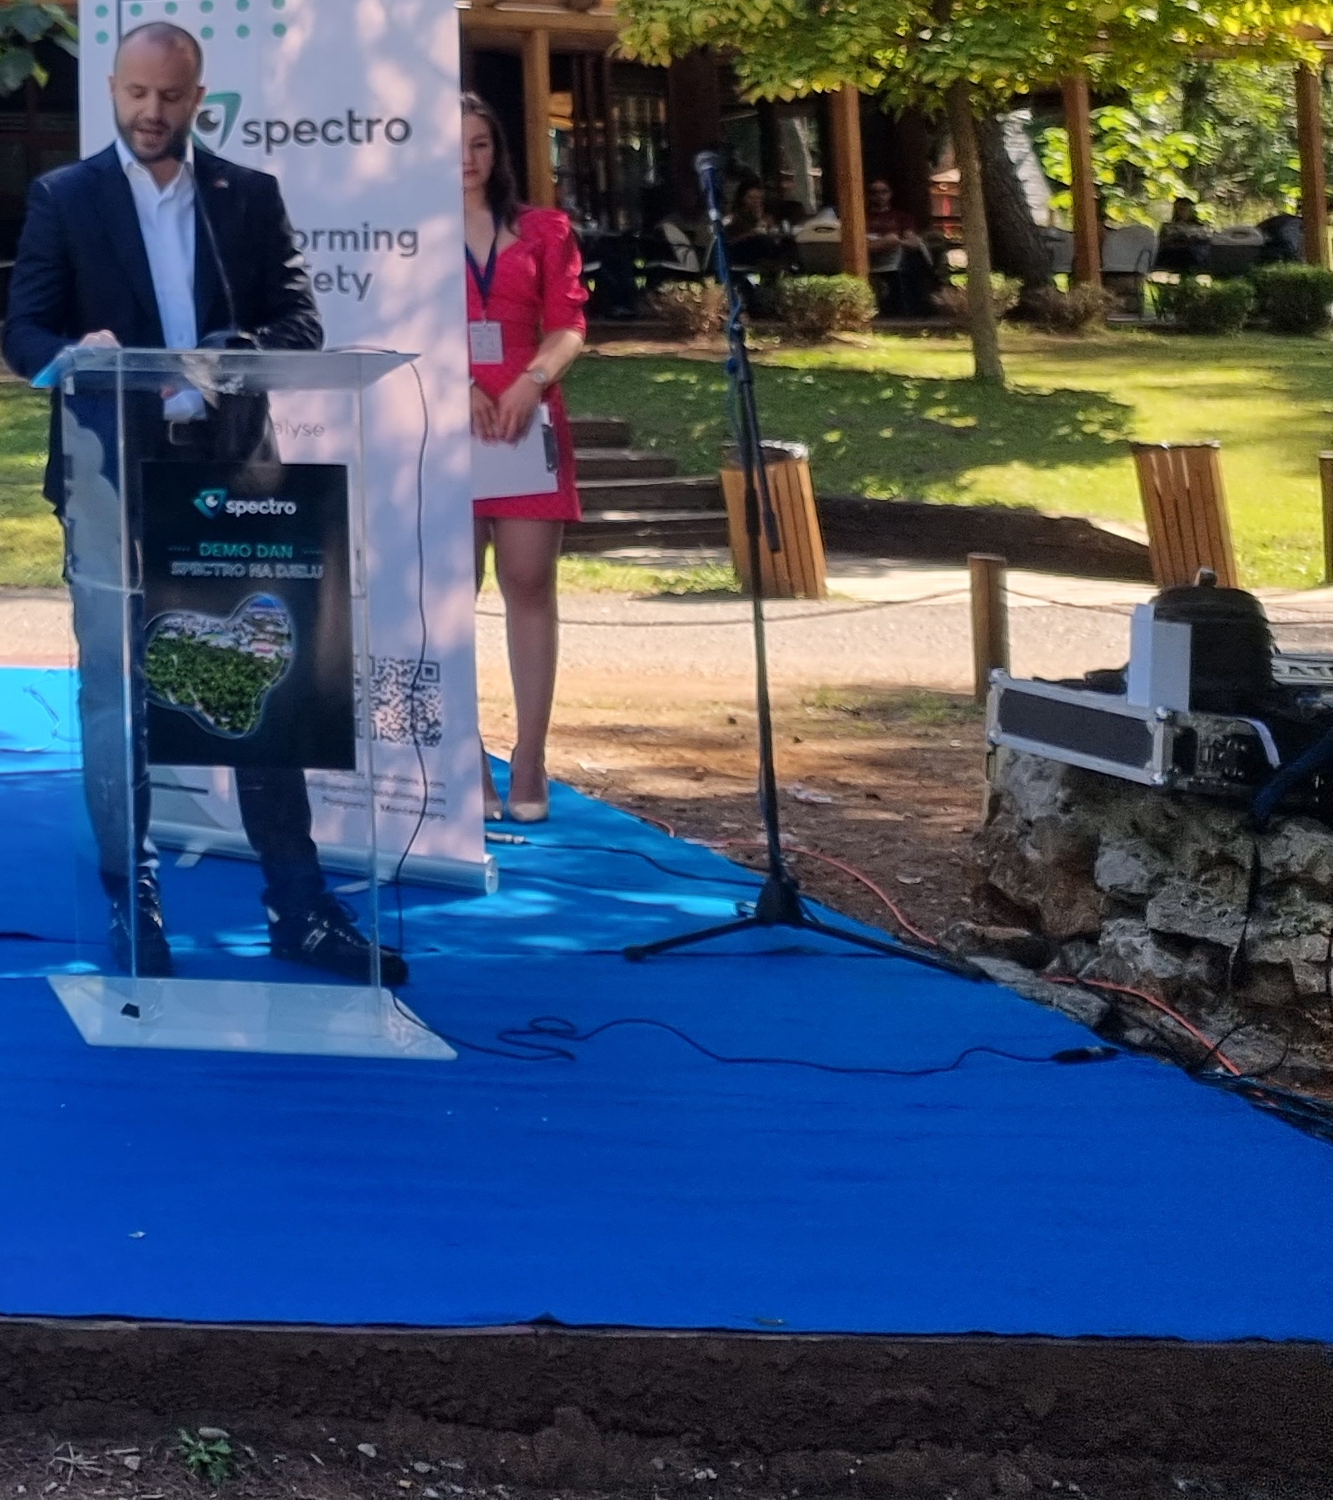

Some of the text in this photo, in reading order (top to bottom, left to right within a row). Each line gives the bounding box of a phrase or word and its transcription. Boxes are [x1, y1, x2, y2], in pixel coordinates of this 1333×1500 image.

[242, 108, 412, 155] spectro
[292, 221, 419, 258] orming
[312, 264, 373, 302] ety
[274, 419, 325, 439] alyse
[225, 497, 297, 518] spectro
[199, 542, 294, 559] DEMO DAN
[171, 561, 324, 580] SPECTRO NA DJELU
